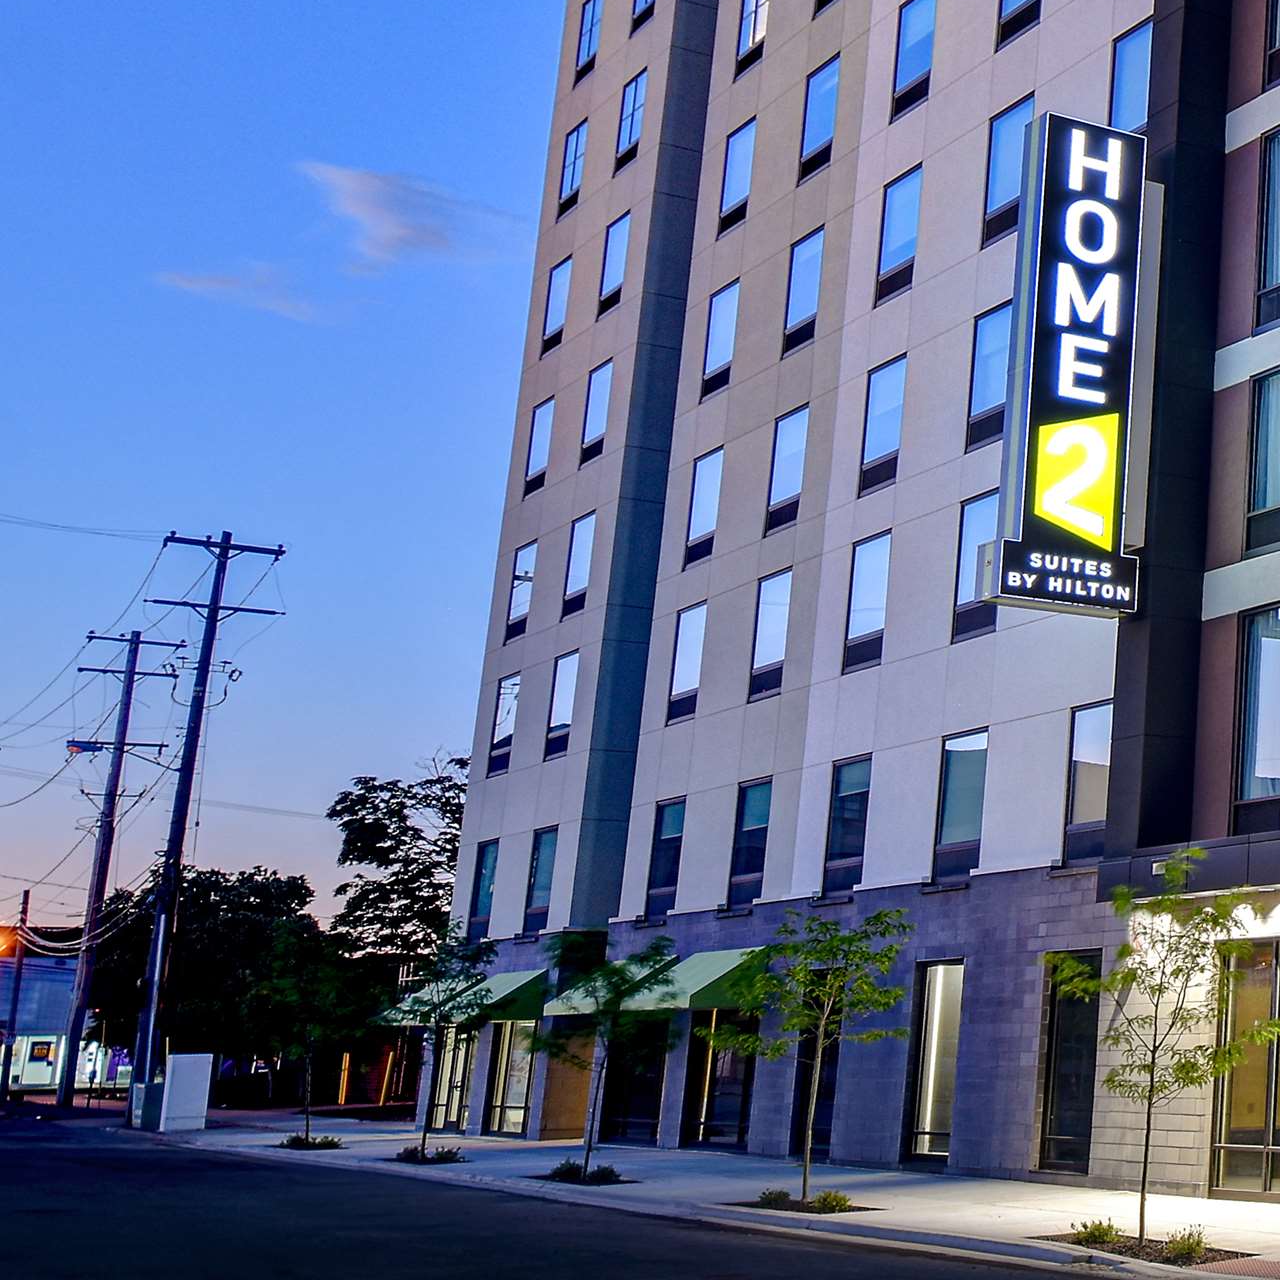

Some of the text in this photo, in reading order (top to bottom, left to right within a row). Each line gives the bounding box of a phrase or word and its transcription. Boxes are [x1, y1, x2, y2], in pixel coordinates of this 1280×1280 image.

[1054, 129, 1122, 404] HOME
[1042, 423, 1108, 537] 2
[1008, 572, 1130, 601] BY HILTON
[1030, 553, 1112, 577] SUITES
